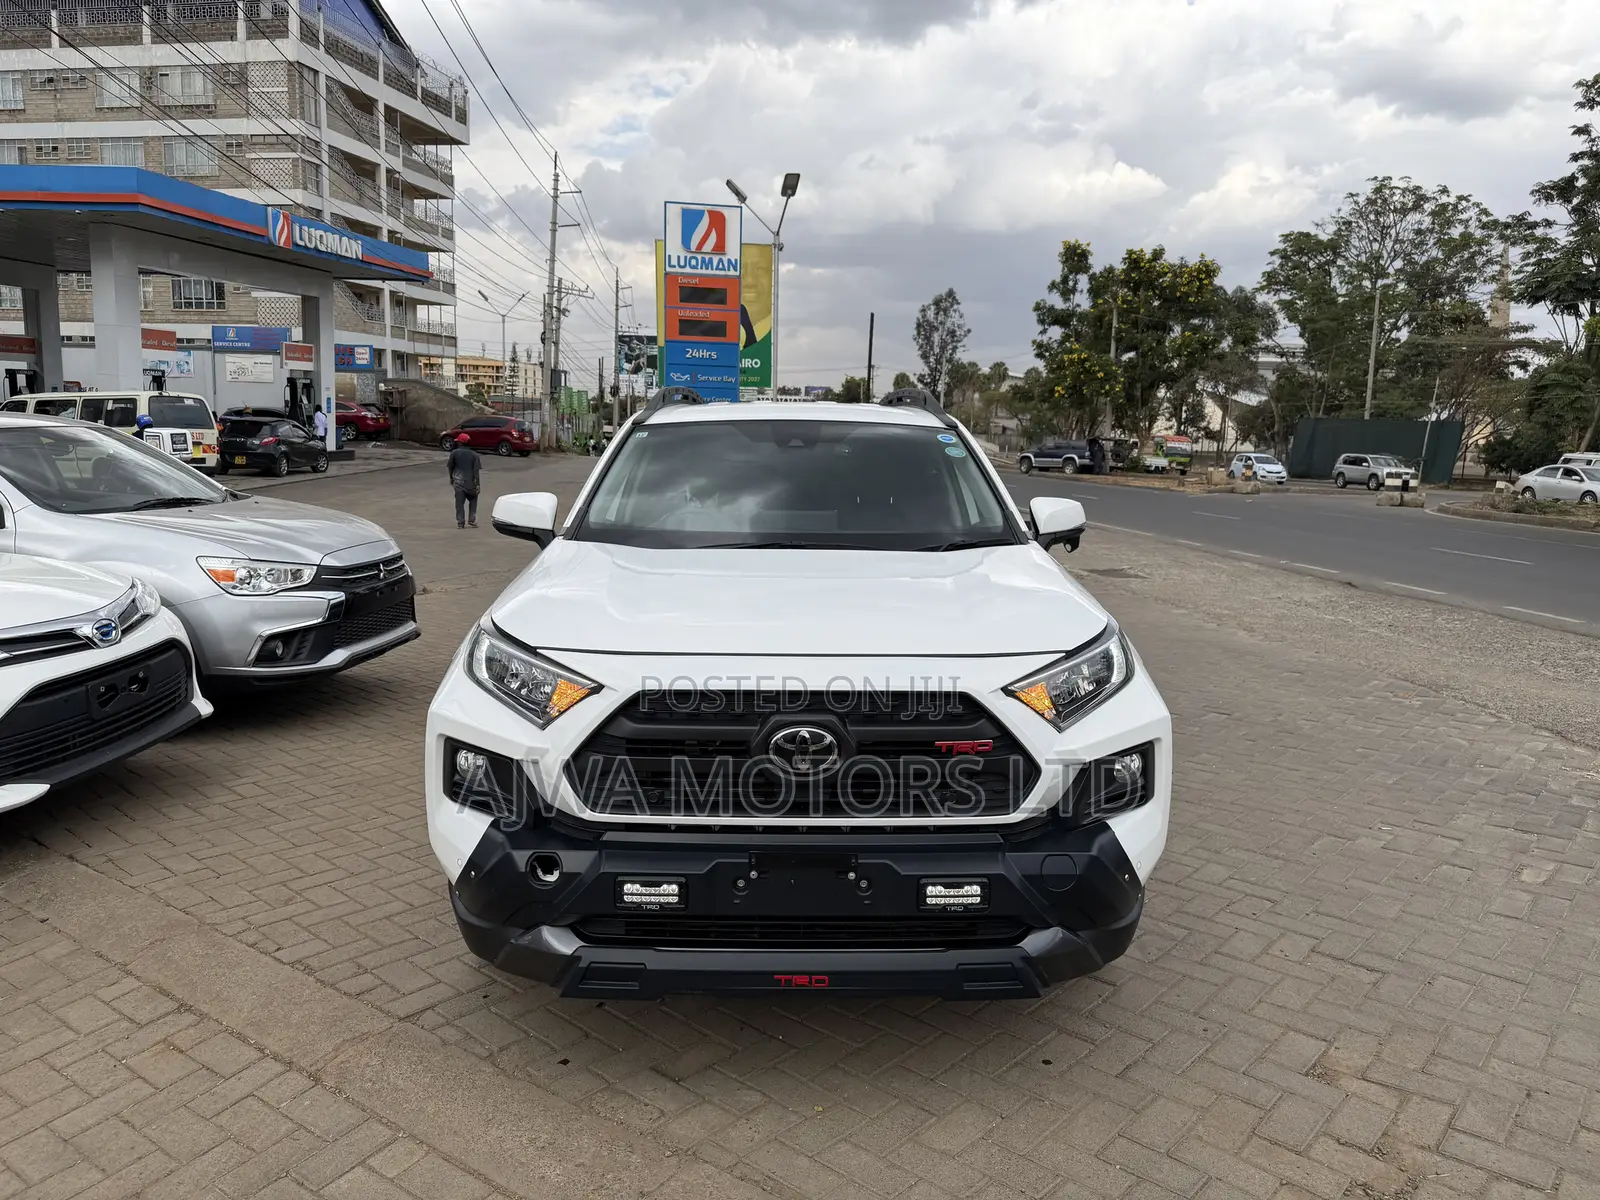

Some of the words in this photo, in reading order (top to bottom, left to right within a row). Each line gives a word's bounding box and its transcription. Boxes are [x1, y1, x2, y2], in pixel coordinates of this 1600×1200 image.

[293, 223, 363, 260] LUQMAN
[667, 254, 739, 272] LUQMAN
[678, 276, 700, 285] Diesel
[678, 309, 711, 319] Unleaded
[335, 347, 354, 355] IVE
[685, 348, 718, 360] 24Hrs
[697, 374, 722, 382] Service
[723, 374, 737, 384] Bay
[935, 739, 994, 757] TRD
[773, 975, 829, 988] TRD
